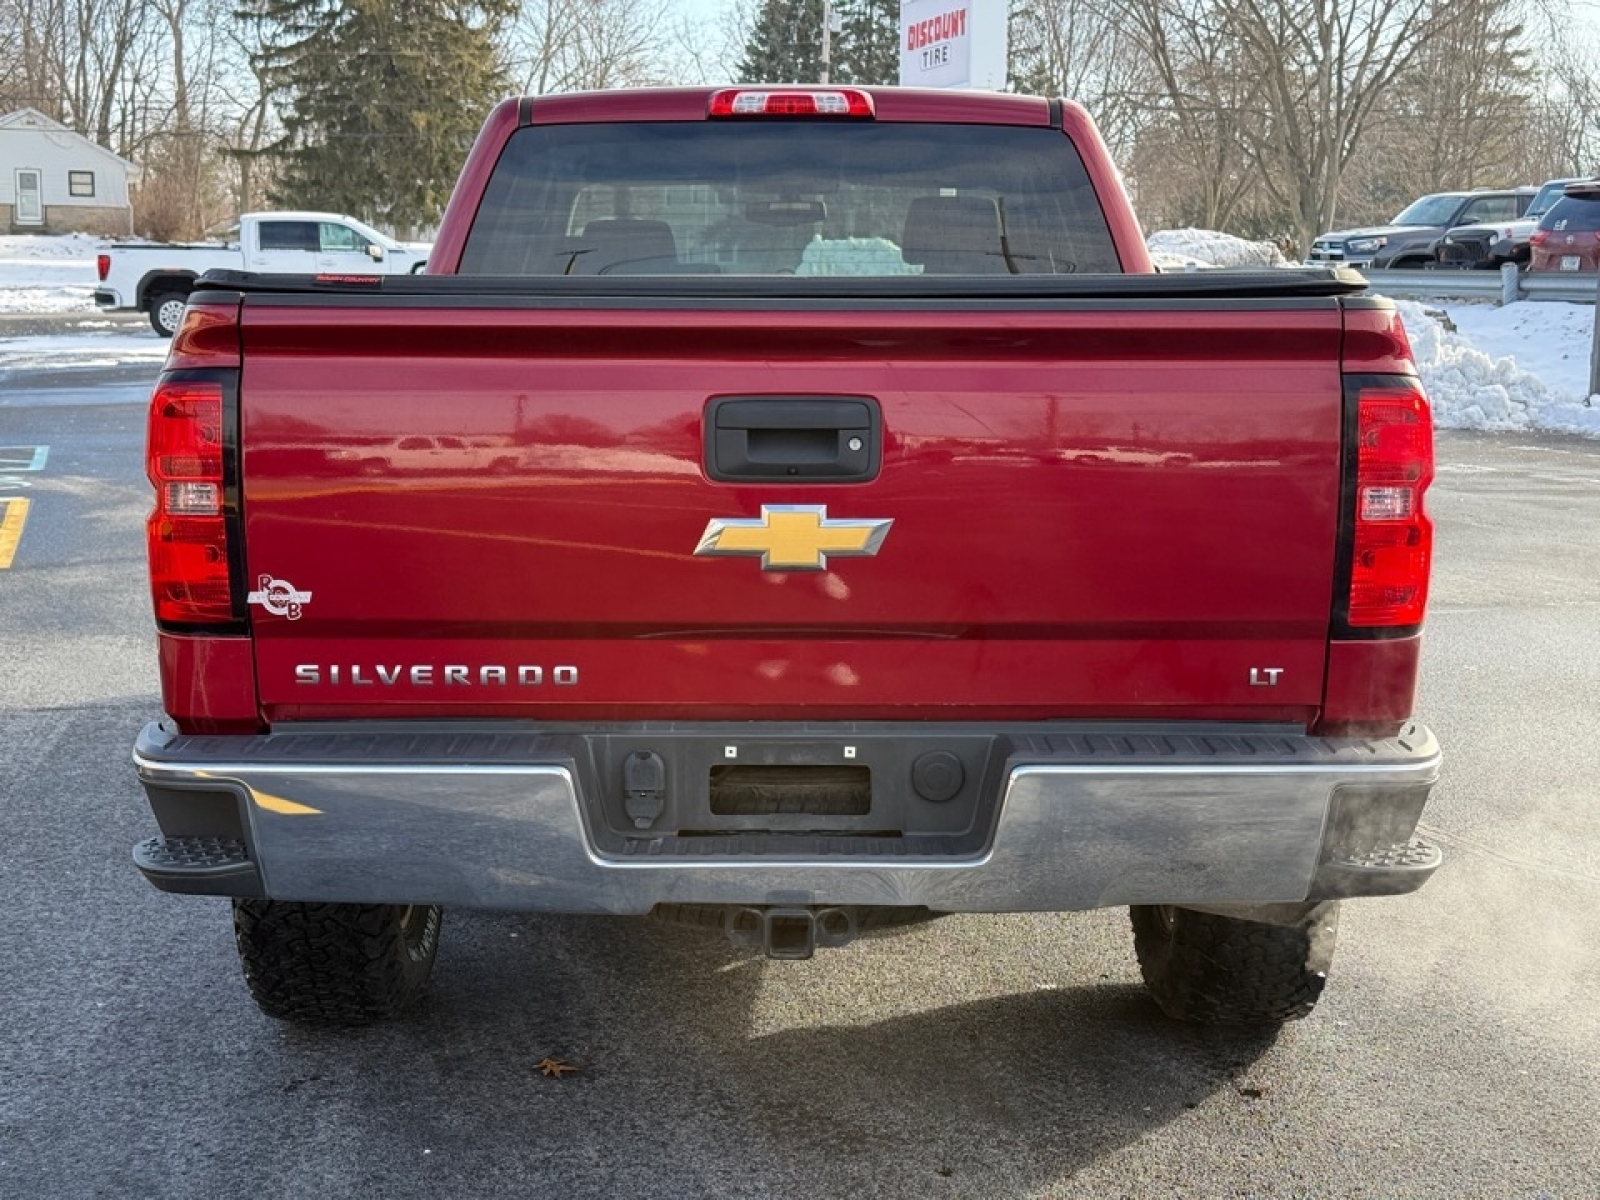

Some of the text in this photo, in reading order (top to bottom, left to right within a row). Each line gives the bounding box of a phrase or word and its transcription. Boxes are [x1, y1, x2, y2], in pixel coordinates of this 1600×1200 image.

[907, 8, 966, 51] DISCOUNT
[922, 45, 948, 68] TIRE
[294, 664, 579, 686] SILVERADO
[1250, 667, 1284, 686] LT
